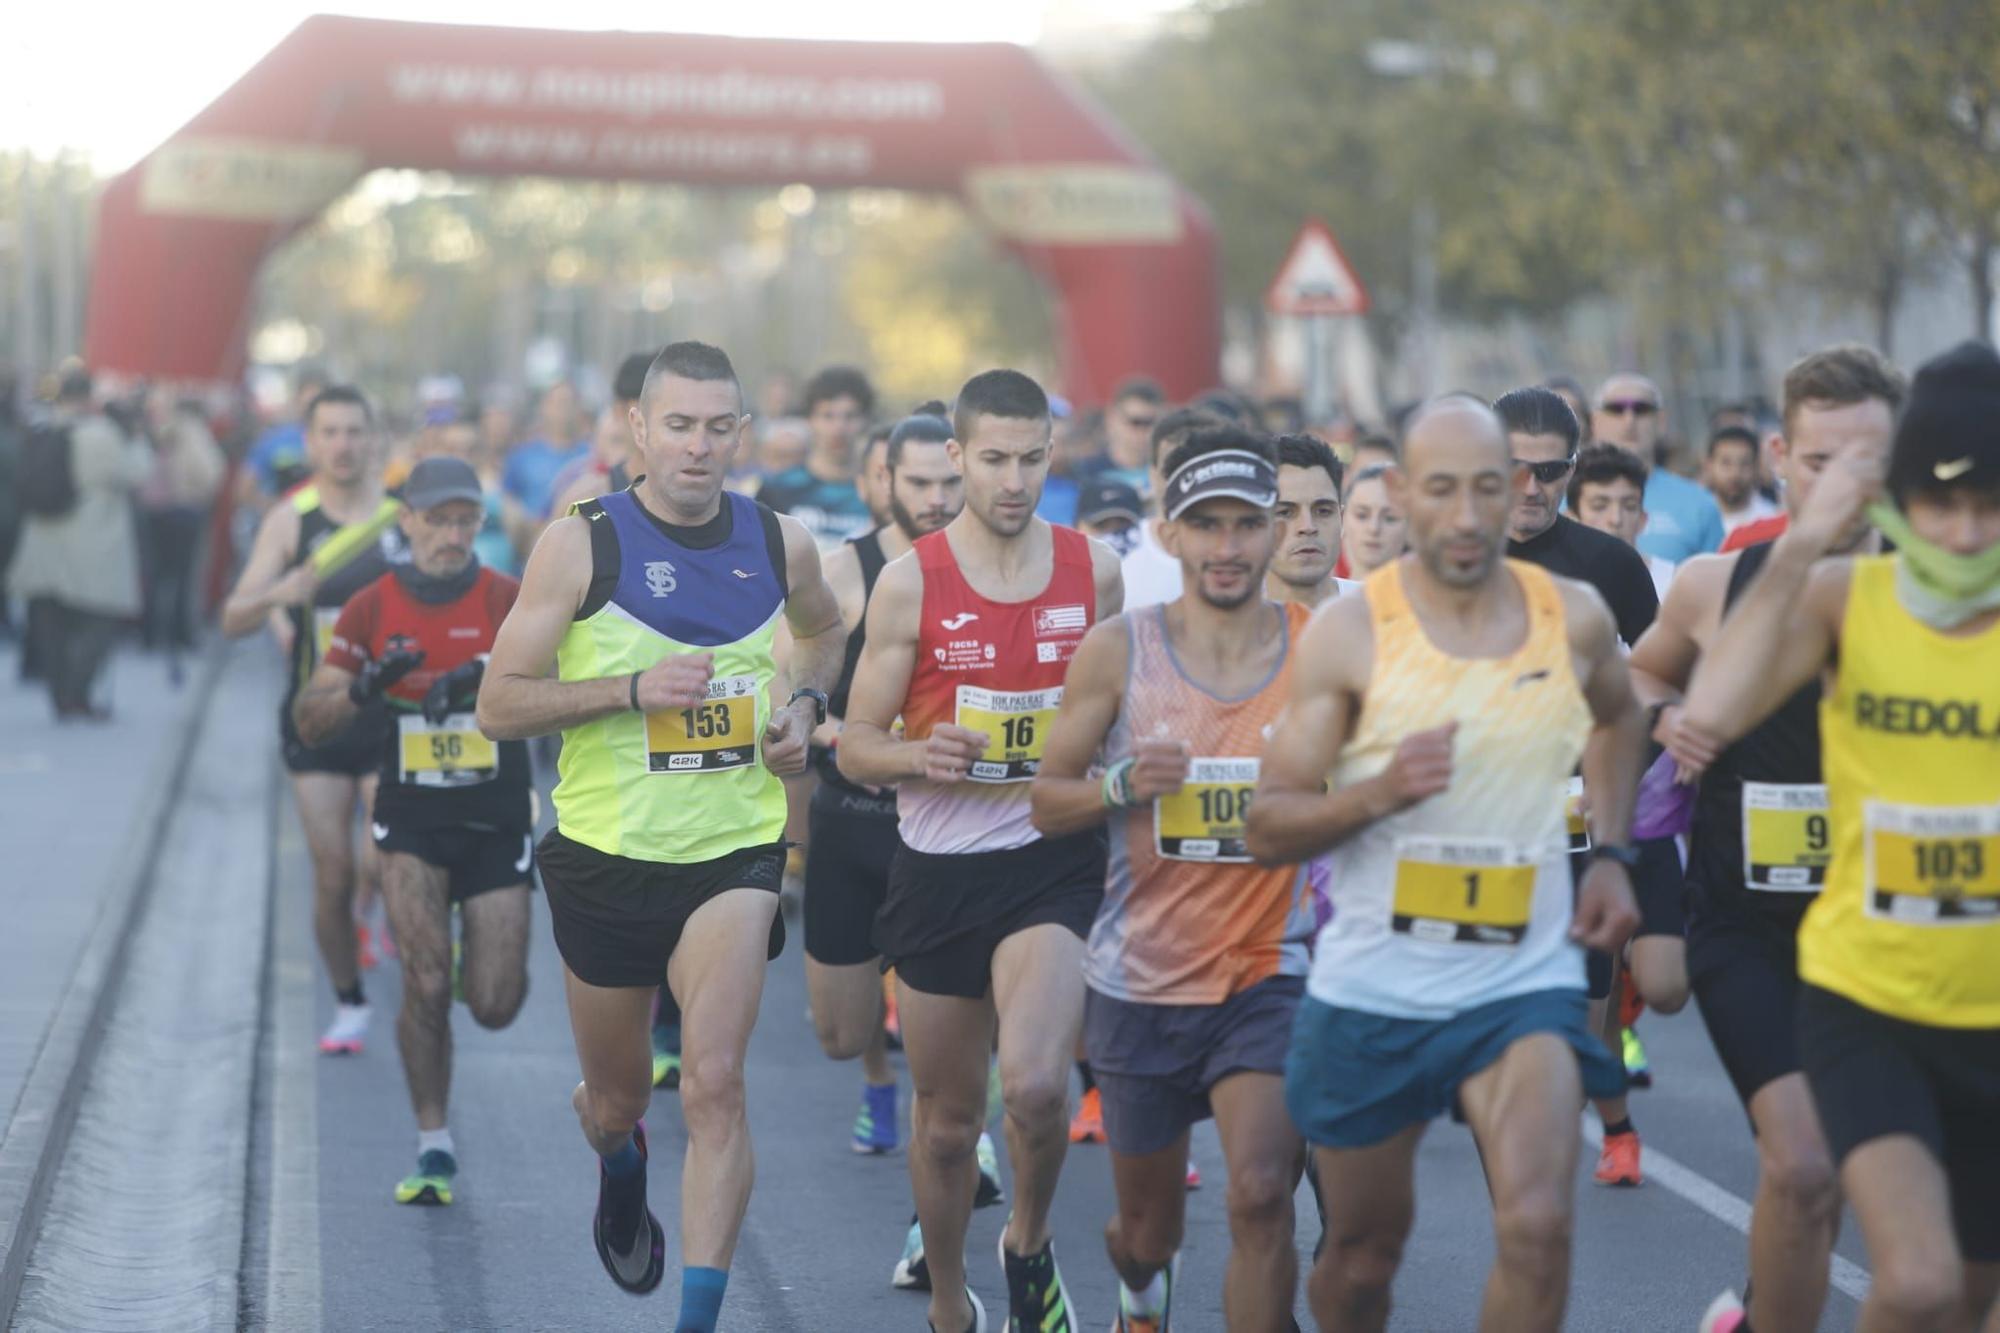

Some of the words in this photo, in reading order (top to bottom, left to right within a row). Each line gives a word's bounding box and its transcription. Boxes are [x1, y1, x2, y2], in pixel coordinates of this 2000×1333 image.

[680, 704, 731, 739] 153
[1001, 716, 1034, 748] 16
[431, 733, 463, 759] 56
[1913, 840, 1984, 881] 103
[1462, 871, 1480, 909] 1
